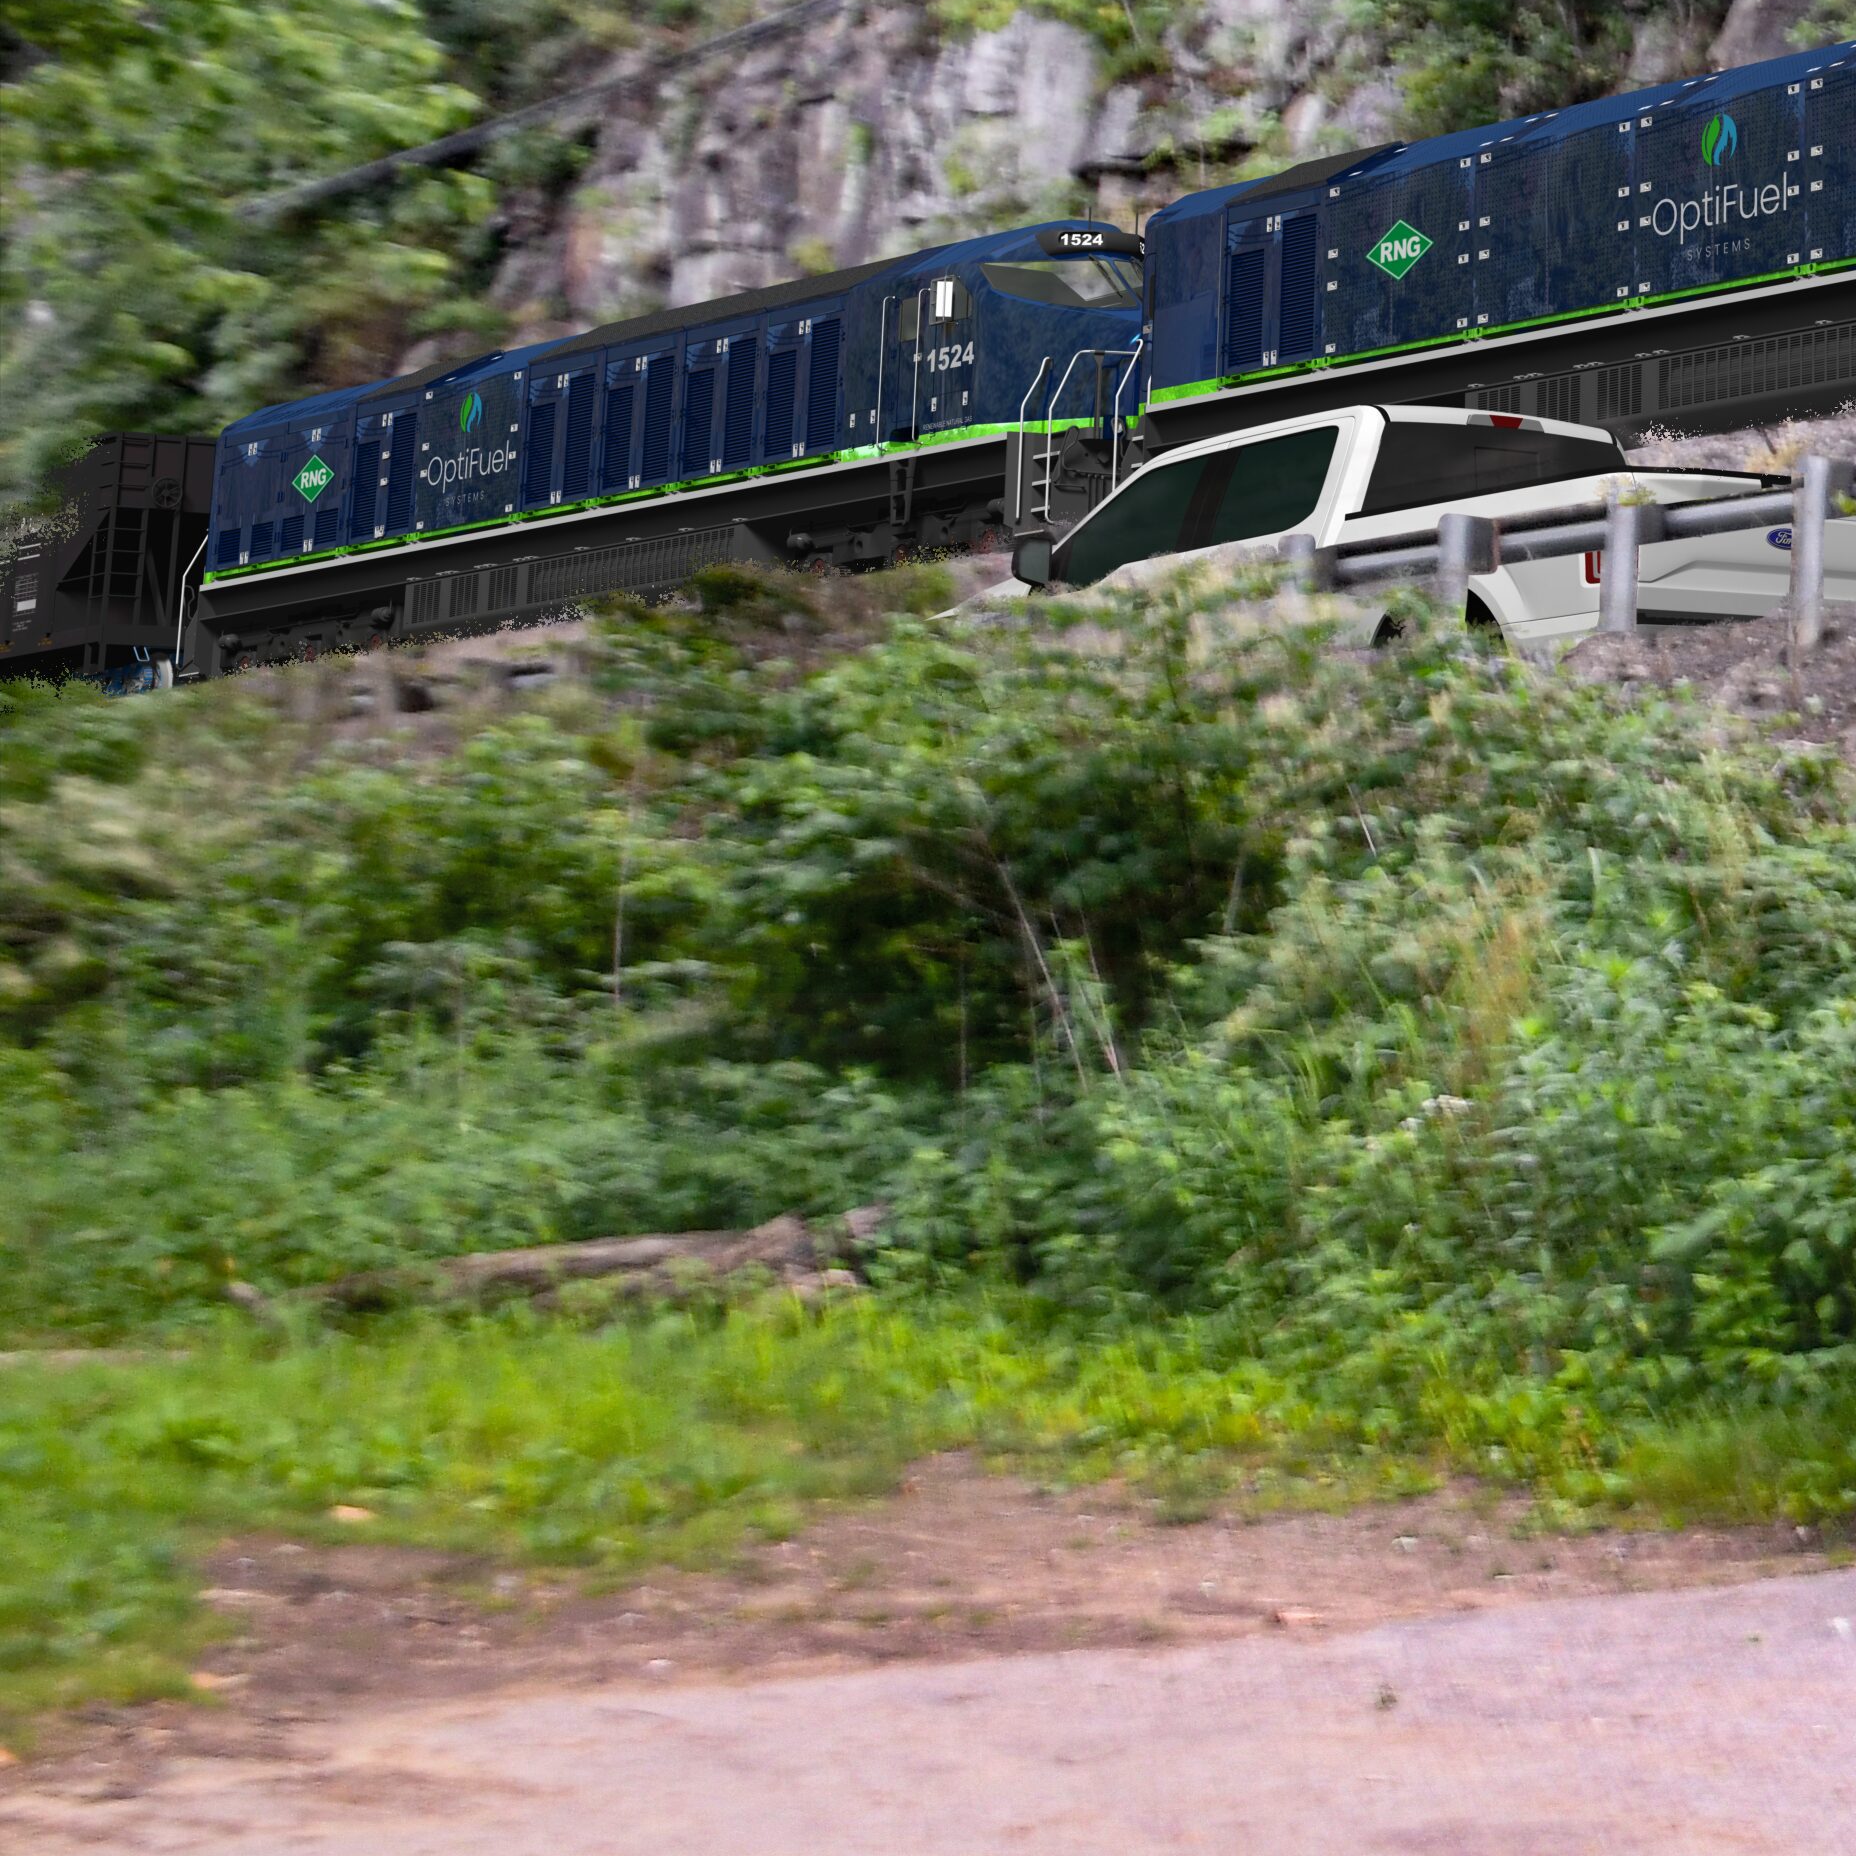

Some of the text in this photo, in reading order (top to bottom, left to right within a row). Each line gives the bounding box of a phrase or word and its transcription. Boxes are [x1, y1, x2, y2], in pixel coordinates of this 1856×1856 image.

[1652, 171, 1787, 245] OptiFuel
[1060, 233, 1104, 246] 1524
[1380, 236, 1421, 264] RNG
[1687, 238, 1750, 261] SYSTEMS
[927, 340, 975, 373] 1524
[301, 468, 327, 489] RNG
[427, 439, 509, 494] OptiFuel
[445, 490, 485, 506] SYSTEMS
